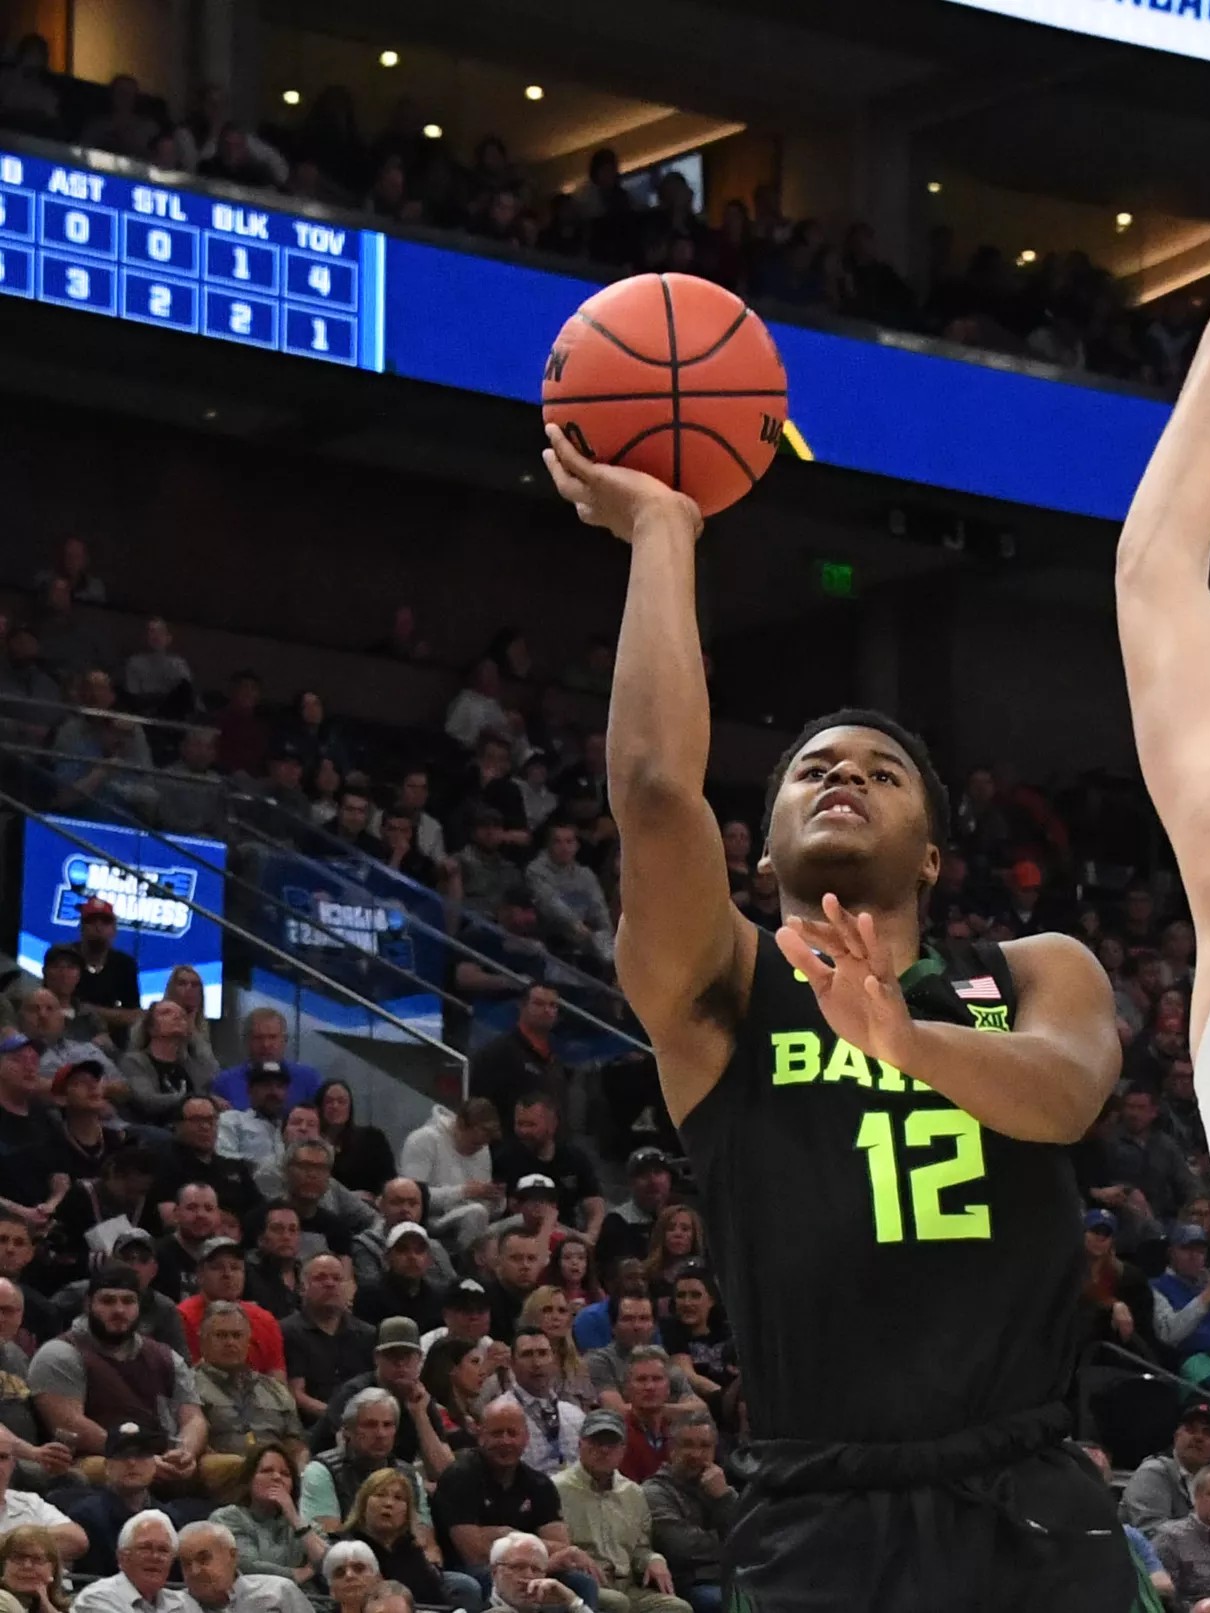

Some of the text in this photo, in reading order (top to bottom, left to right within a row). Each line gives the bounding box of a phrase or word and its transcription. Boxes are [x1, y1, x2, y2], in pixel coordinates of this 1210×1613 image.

[49, 167, 104, 202] AST
[132, 186, 187, 221] STL
[212, 203, 268, 239] BLK
[293, 220, 346, 256] TOV
[65, 210, 331, 297] 0 0 1 4
[66, 267, 330, 351] 3 2 2 1
[856, 1109, 991, 1243] 12
